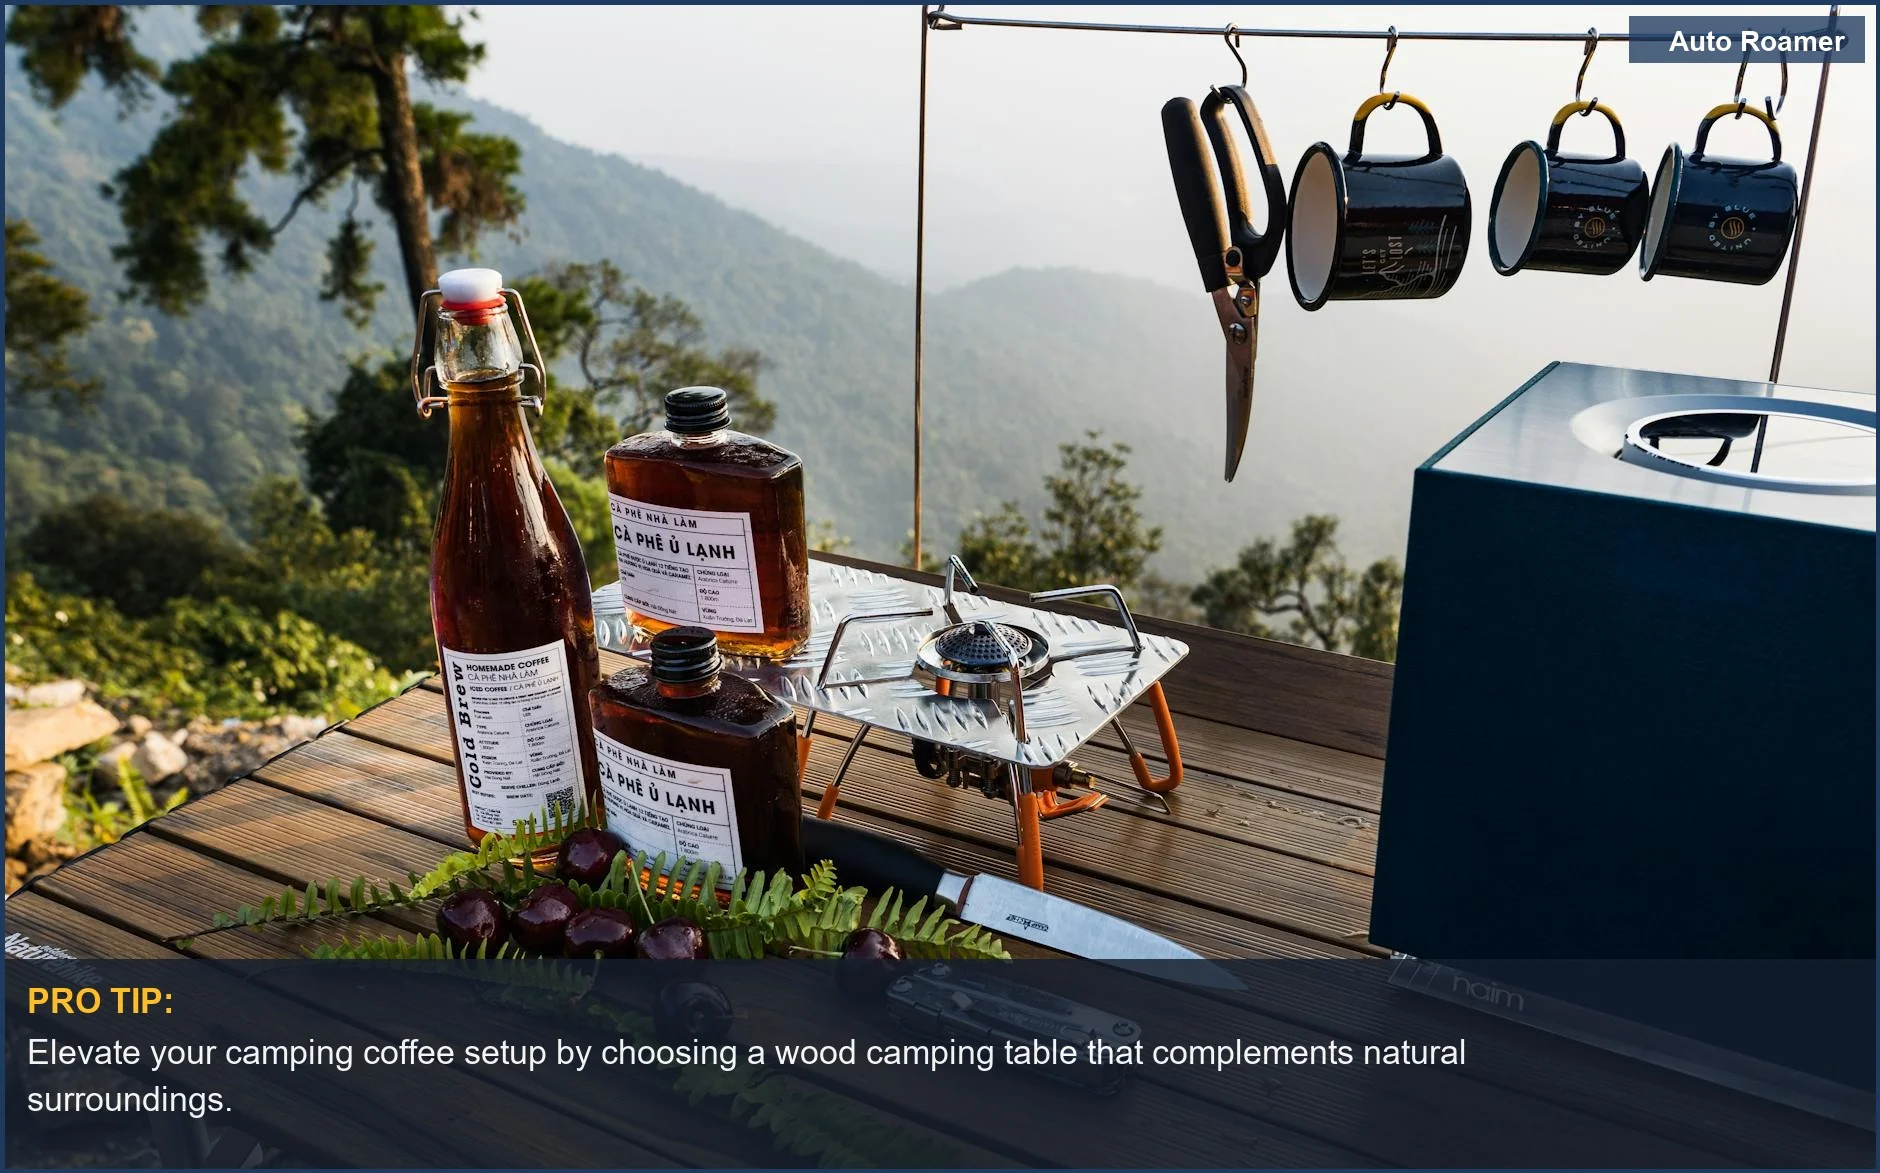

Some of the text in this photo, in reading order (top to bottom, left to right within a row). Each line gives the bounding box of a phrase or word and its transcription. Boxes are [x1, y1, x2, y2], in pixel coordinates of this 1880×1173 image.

[1362, 249, 1376, 275] LET'S
[1388, 235, 1403, 260] LOST
[610, 502, 697, 529] CÀ PHÊ NHÀ LÀM
[614, 525, 736, 562] CÀ PHÊ Ủ LẠNH
[466, 656, 550, 672] HOMEMADE COFFEE
[468, 669, 539, 681] CÀ PHÊ NHÀ LÀM
[452, 661, 481, 789] Cold Brew
[607, 746, 623, 761] PHÊ
[627, 756, 648, 771] NHÀ
[653, 765, 676, 779] LÀM
[599, 762, 715, 815] CÀ PHÊ Ủ LẠNH
[1453, 974, 1524, 1012] naim
